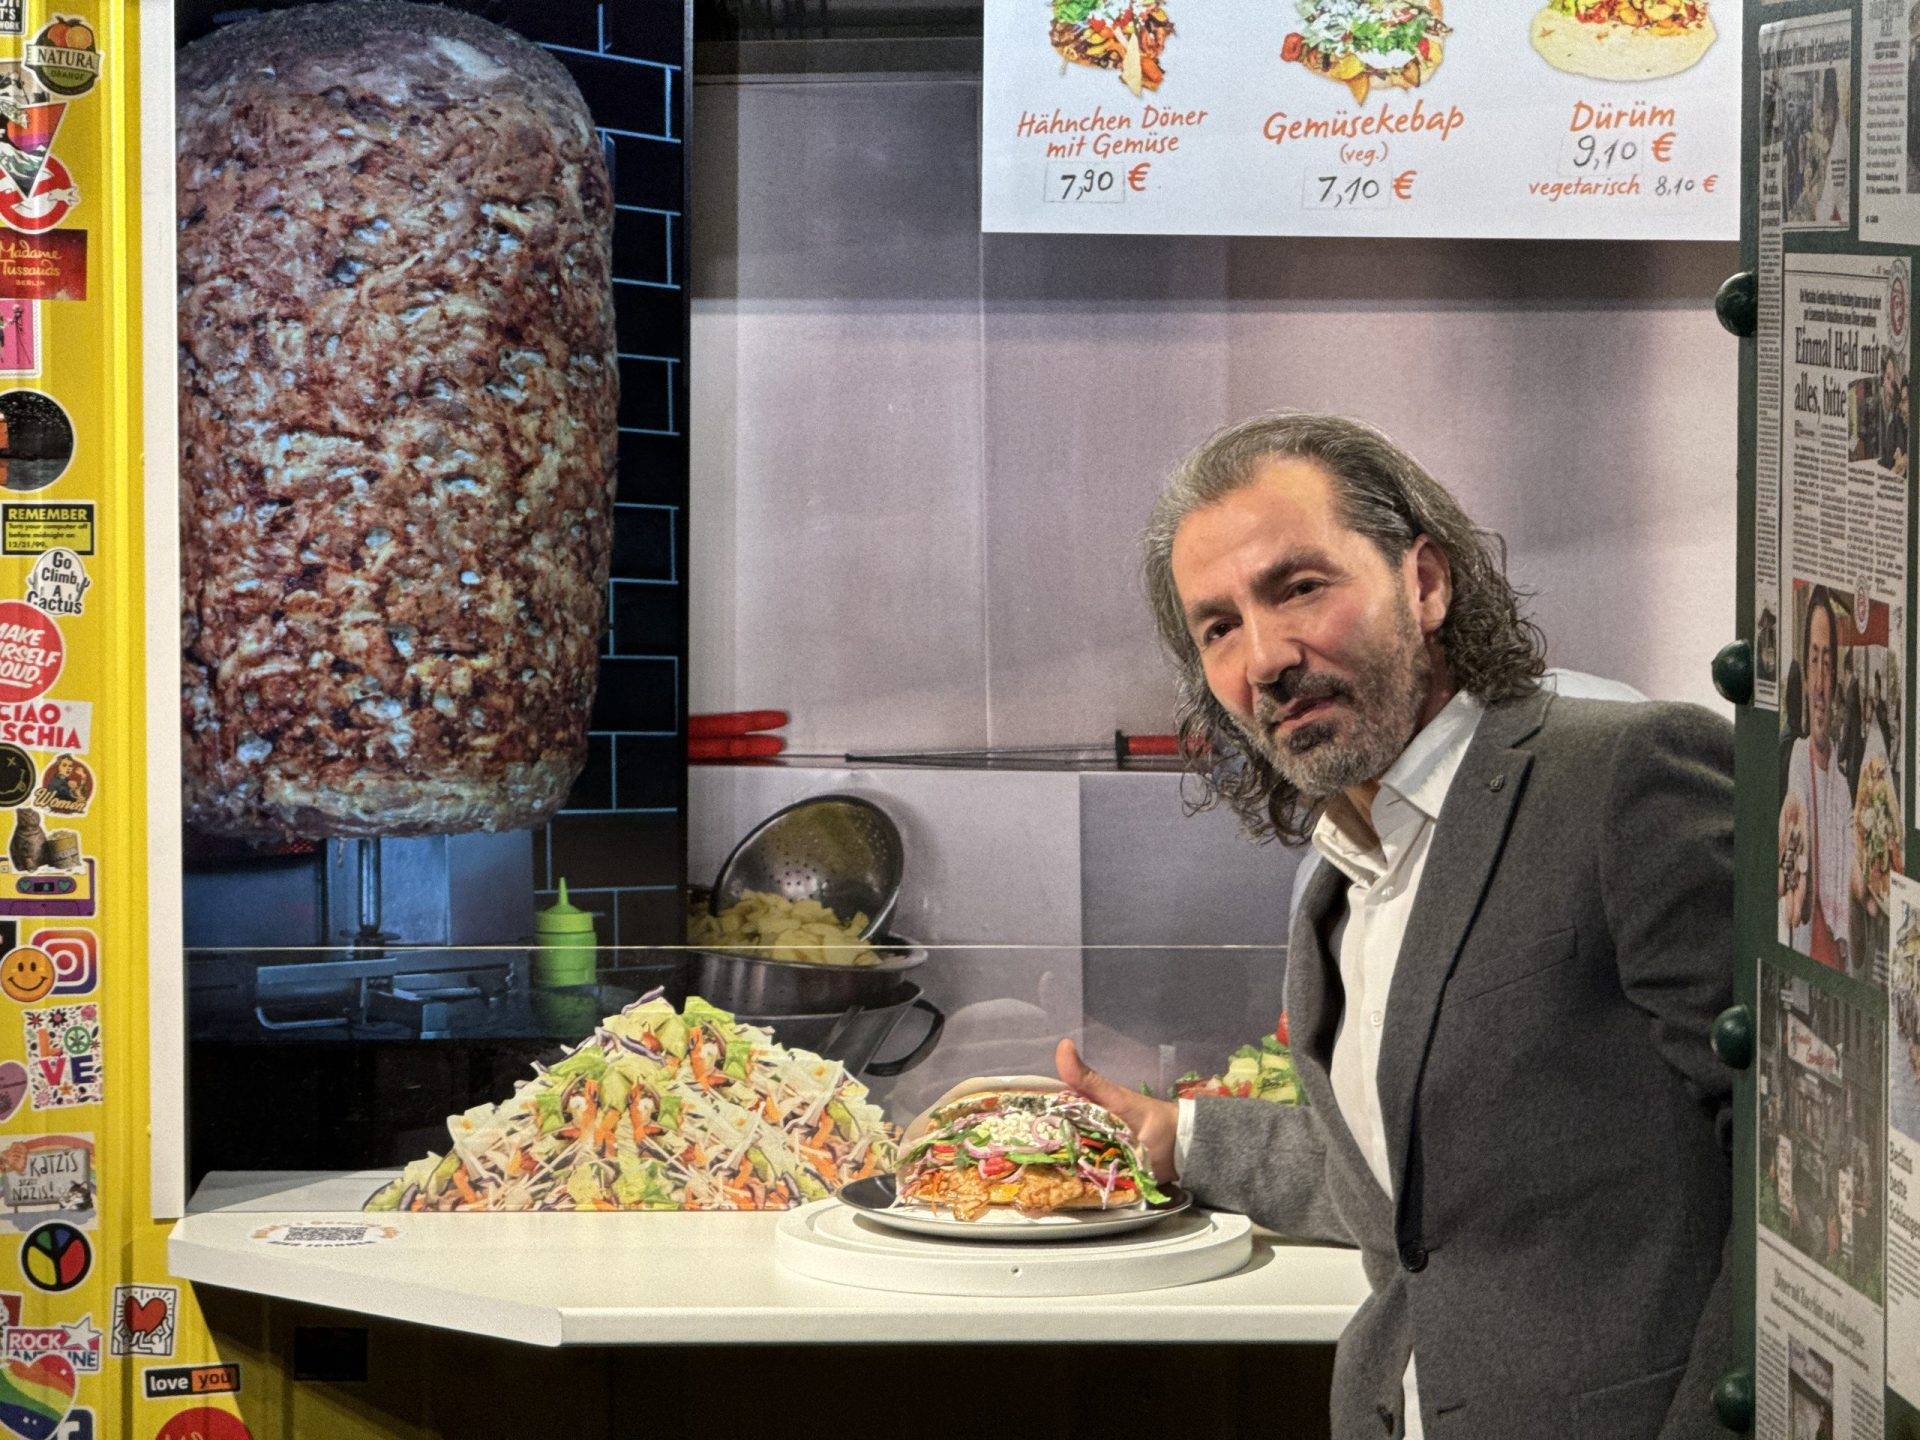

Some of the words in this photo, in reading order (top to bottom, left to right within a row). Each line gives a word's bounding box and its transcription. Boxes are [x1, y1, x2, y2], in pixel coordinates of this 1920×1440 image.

[38, 48, 95, 69] NATURA
[1017, 106, 1131, 137] Hähnchen
[1141, 104, 1208, 129] Döner
[1263, 98, 1464, 145] Gemüsekebap
[1569, 100, 1675, 132] Dürüm
[1046, 135, 1087, 158] mit
[1093, 133, 1180, 159] Gemüse
[1339, 141, 1389, 167] (veg.)
[1573, 134, 1637, 170] 9,10
[1651, 132, 1677, 162] €
[1060, 168, 1114, 200] 7,90
[1127, 162, 1152, 191] €
[1318, 176, 1380, 207] 7,10
[1392, 170, 1418, 199] €
[1528, 174, 1640, 201] vegetarisch
[1703, 174, 1719, 193] €
[1795, 327, 1831, 367] Einmal
[1835, 329, 1858, 371] Held
[1860, 334, 1879, 374] mit
[1794, 371, 1820, 423] alles,
[1823, 374, 1846, 418] bitte
[8, 508, 87, 520] REMEMBER
[52, 551, 72, 569] Go
[41, 567, 77, 584] Climb
[27, 591, 82, 614] Cactus
[52, 585, 61, 597] A
[33, 787, 87, 809] Women
[9, 1333, 61, 1350] ROCK
[150, 1376, 189, 1391] love
[198, 1373, 232, 1388] you
